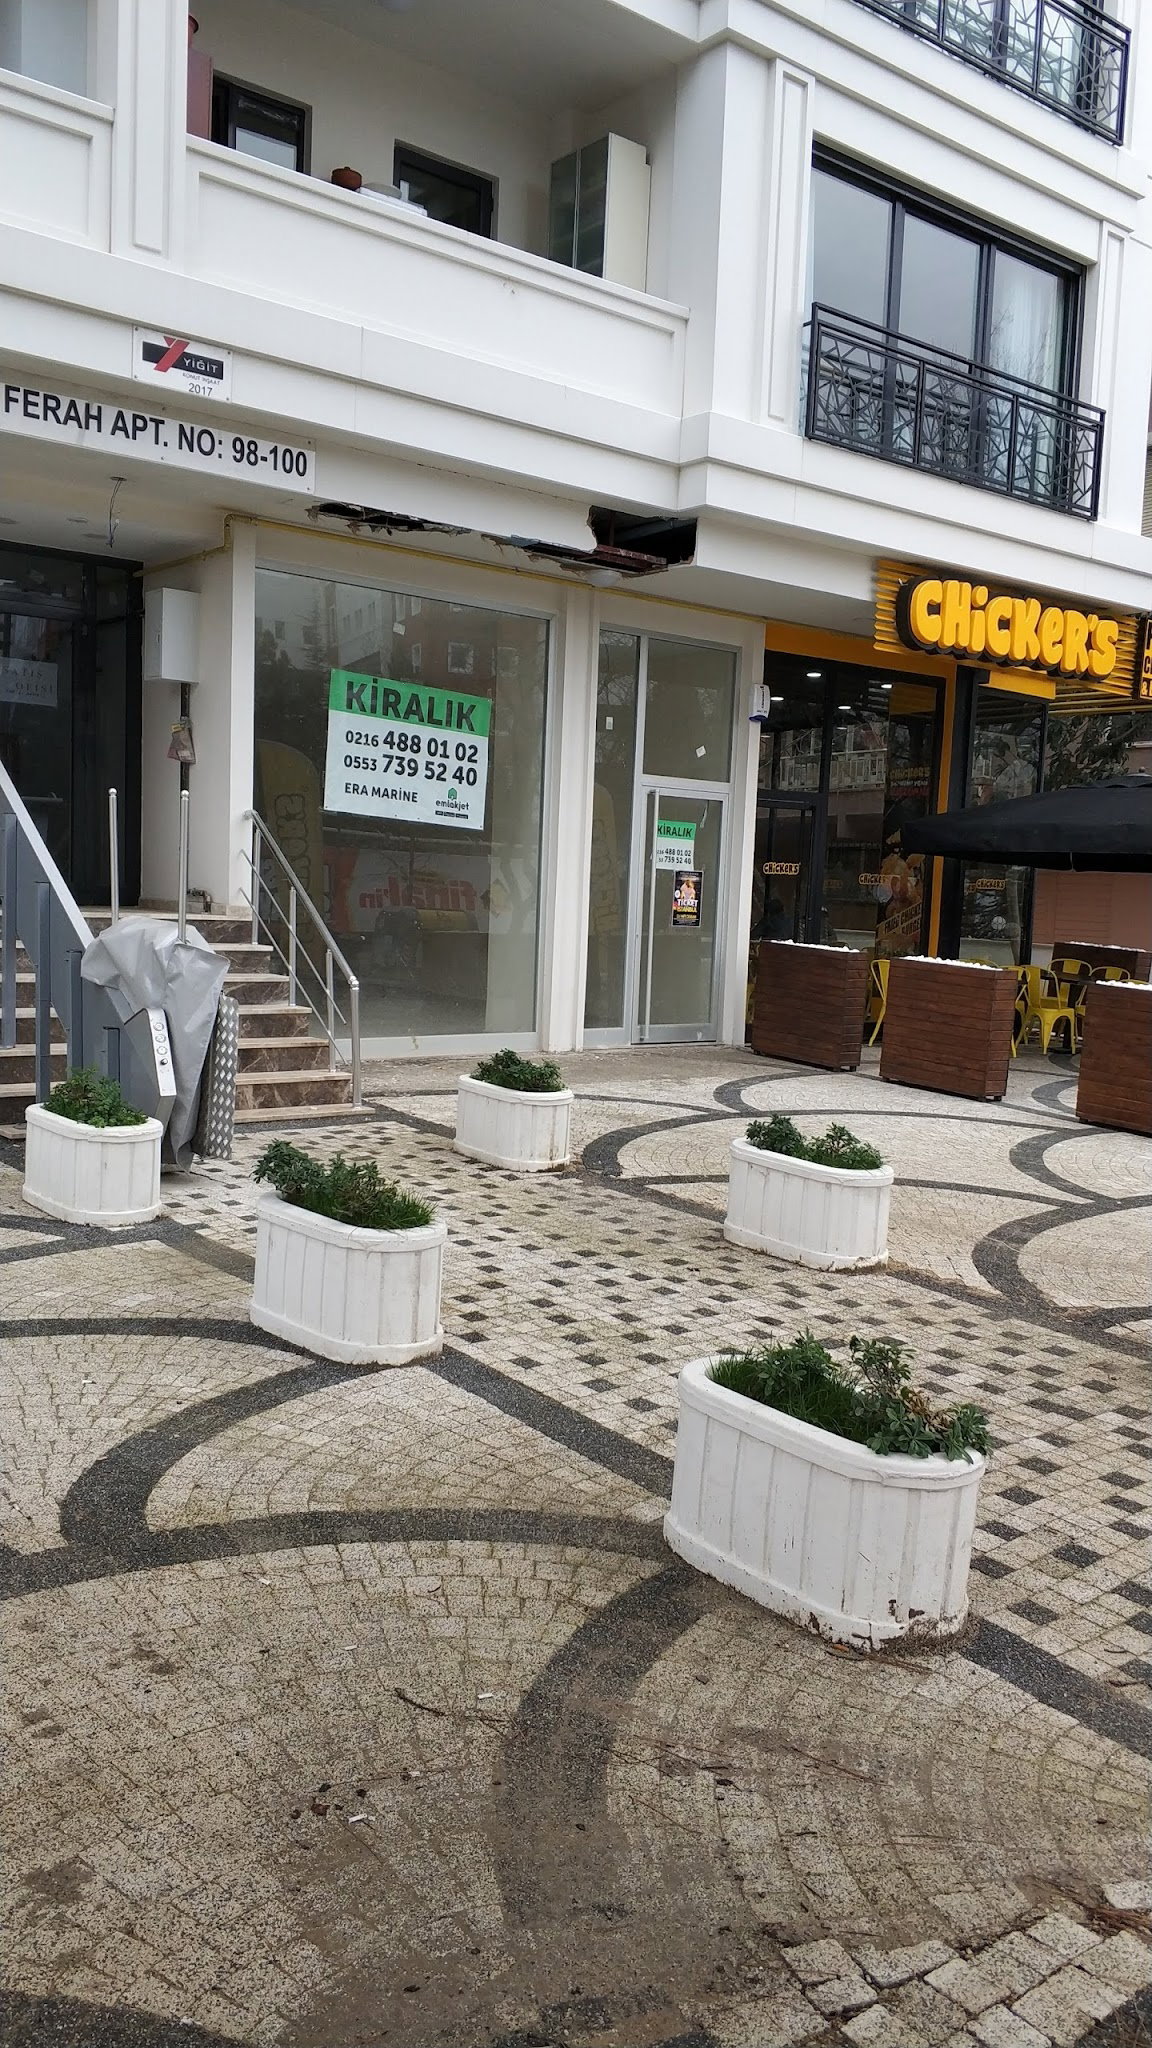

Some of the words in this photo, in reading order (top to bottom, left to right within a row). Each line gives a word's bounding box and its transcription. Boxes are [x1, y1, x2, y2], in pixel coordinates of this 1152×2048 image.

[183, 357, 219, 374] YİĞİT
[188, 382, 213, 397] 2017
[4, 384, 102, 433] FERAH
[111, 410, 168, 448] APT.
[178, 423, 223, 459] NO:
[232, 436, 308, 477] 98-100
[345, 678, 477, 732] KİRALIK
[345, 730, 379, 748] 0216
[383, 730, 421, 754] 488
[427, 738, 450, 760] 01
[455, 743, 478, 764] 02
[344, 755, 377, 772] 0553
[382, 754, 419, 777] 739
[424, 761, 447, 782] 52
[452, 766, 477, 786] 40
[344, 783, 369, 796] ERA
[371, 784, 418, 803] MARİNE
[435, 799, 470, 812] emlakjet
[657, 823, 693, 838] KİRALIK
[665, 848, 676, 856] 488
[684, 849, 692, 857] 02
[683, 857, 692, 865] 40
